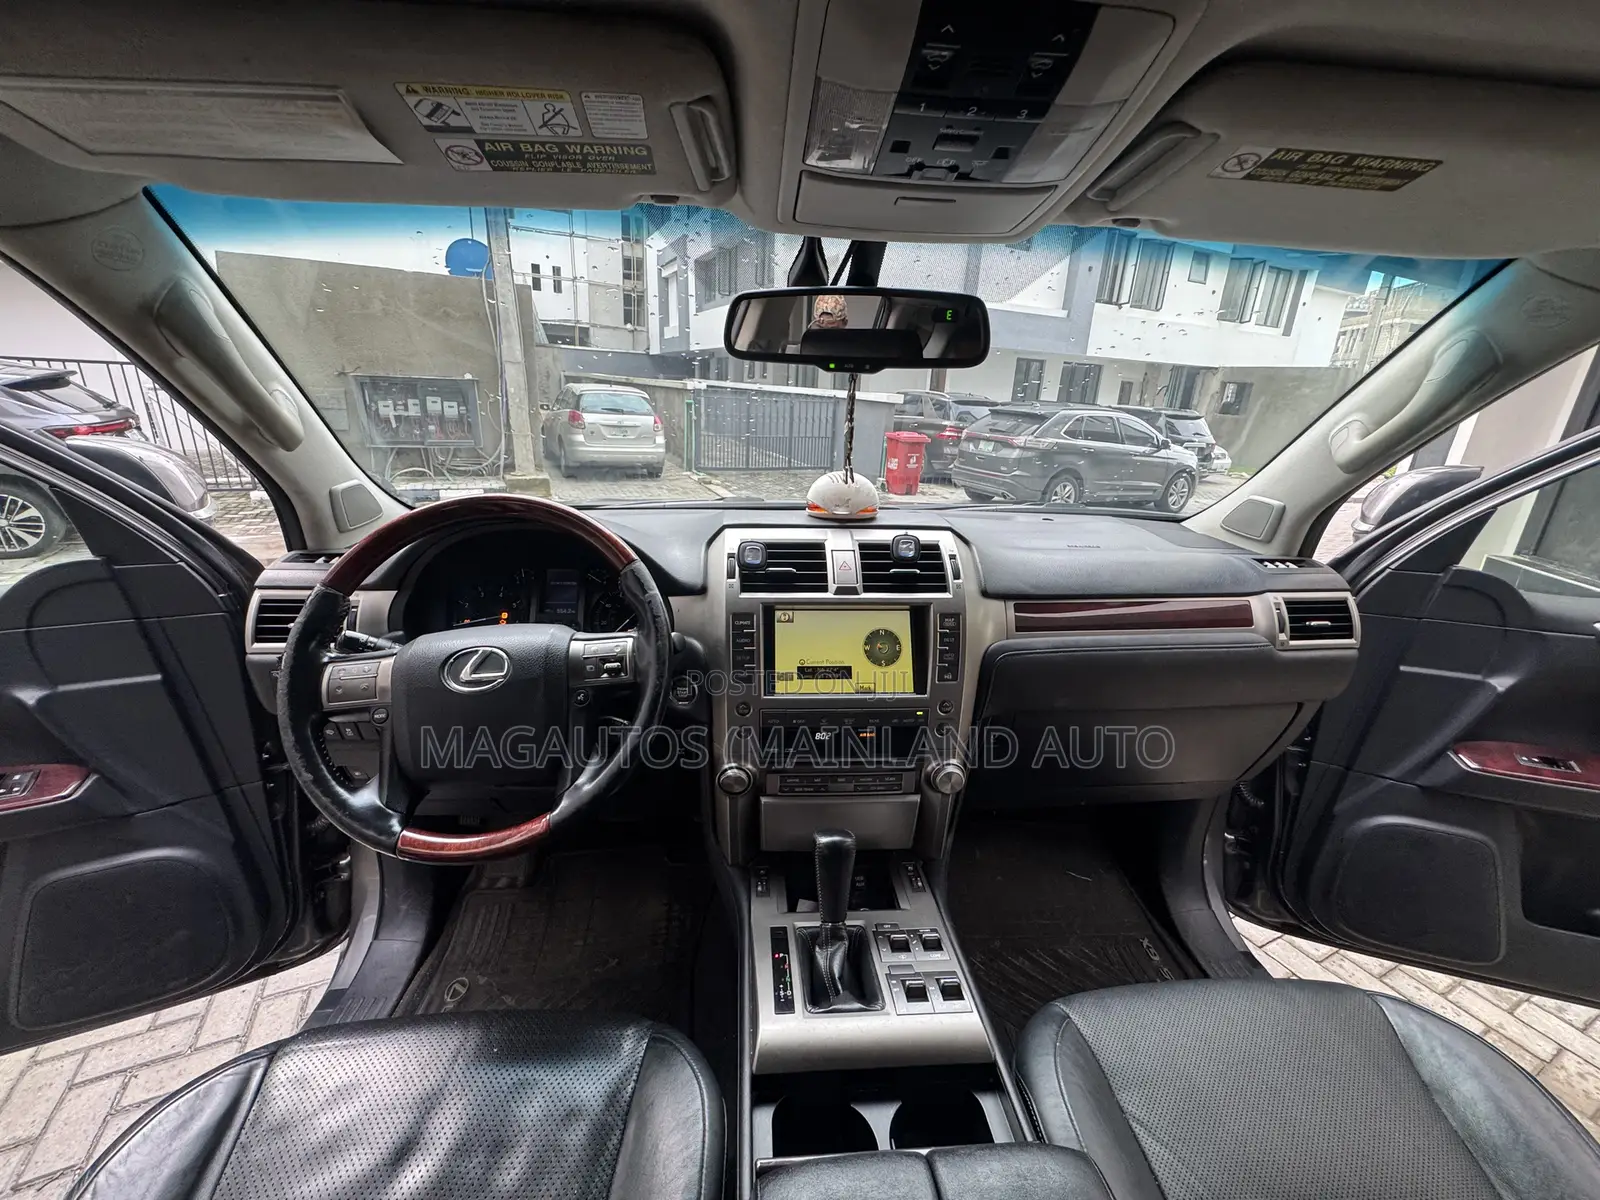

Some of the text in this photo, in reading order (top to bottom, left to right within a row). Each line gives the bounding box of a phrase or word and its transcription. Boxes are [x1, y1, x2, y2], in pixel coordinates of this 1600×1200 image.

[506, 91, 547, 99] ROLLOVER
[920, 102, 926, 112] 1
[966, 106, 978, 116] 2
[1016, 109, 1029, 119] 3
[484, 142, 648, 155] AIR BAG WARNING
[1268, 151, 1306, 161] AIR
[1306, 153, 1349, 165] BAG
[1351, 156, 1437, 172] WARNING
[946, 309, 953, 321] E
[881, 659, 886, 667] S
